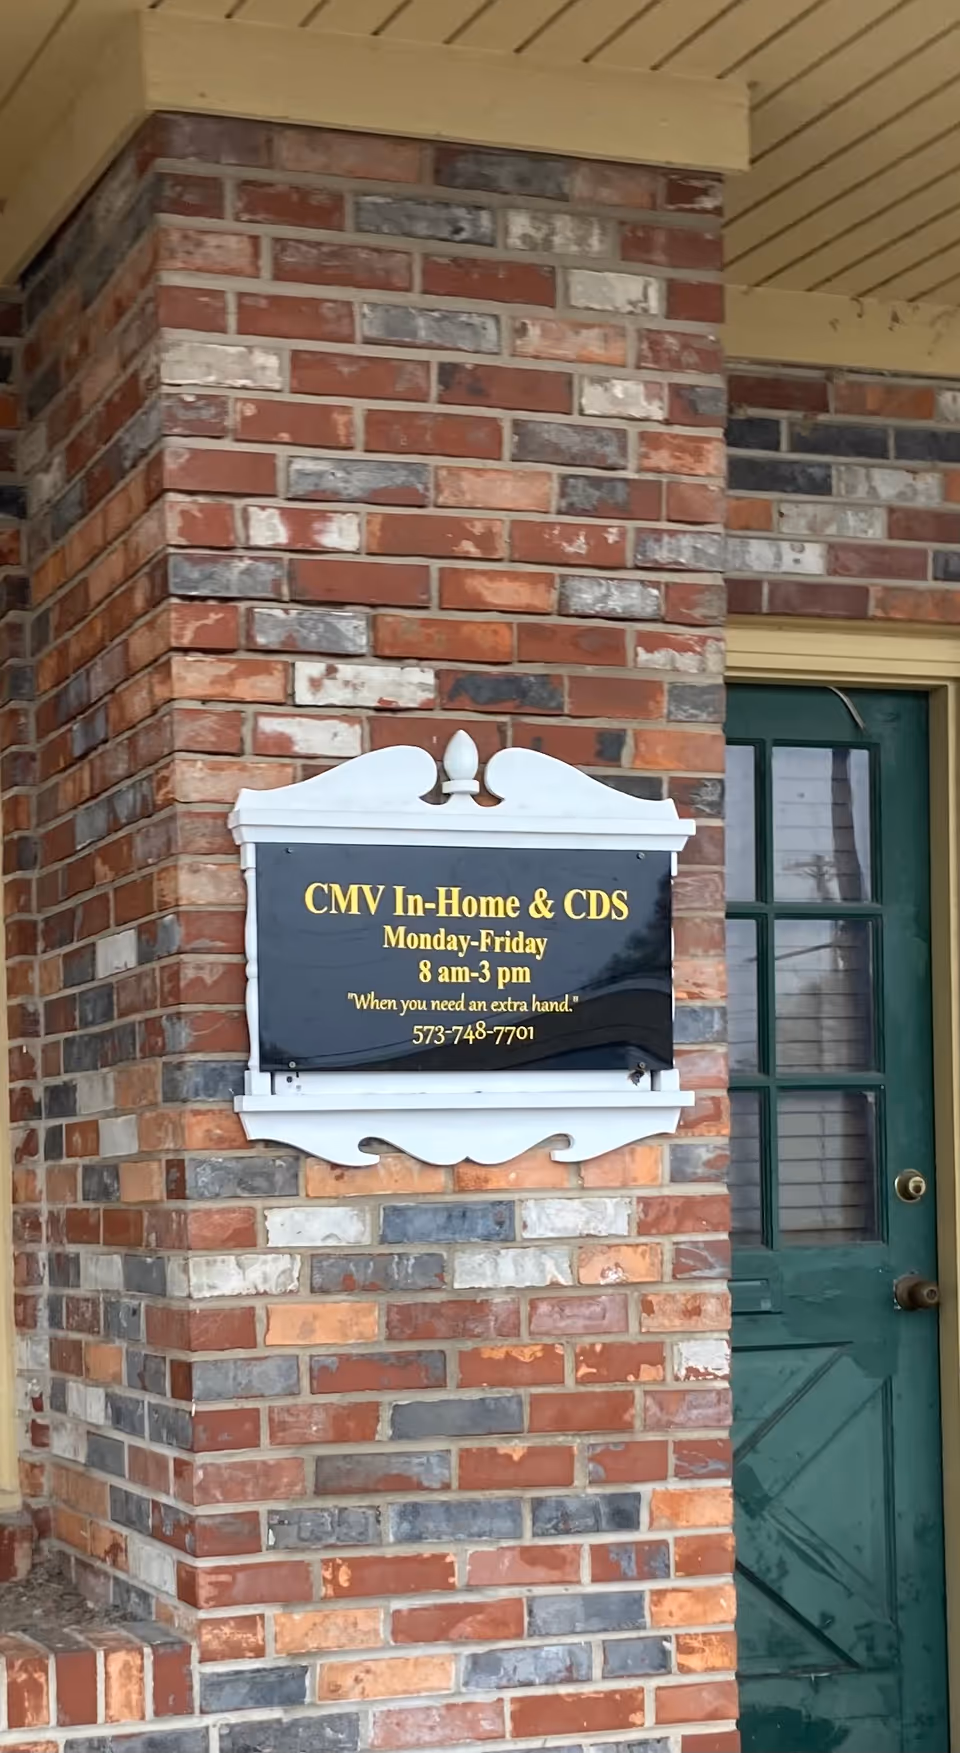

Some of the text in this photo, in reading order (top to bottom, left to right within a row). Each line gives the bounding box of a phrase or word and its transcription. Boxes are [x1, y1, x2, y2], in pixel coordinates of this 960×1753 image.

[304, 882, 629, 920] CMV In-Home & CDS
[383, 925, 548, 959] Monday-Friday
[418, 960, 530, 989] 8 am-3 pm
[347, 992, 579, 1016] "When you need an extra hand."
[414, 1022, 533, 1044] 573-748-7701
